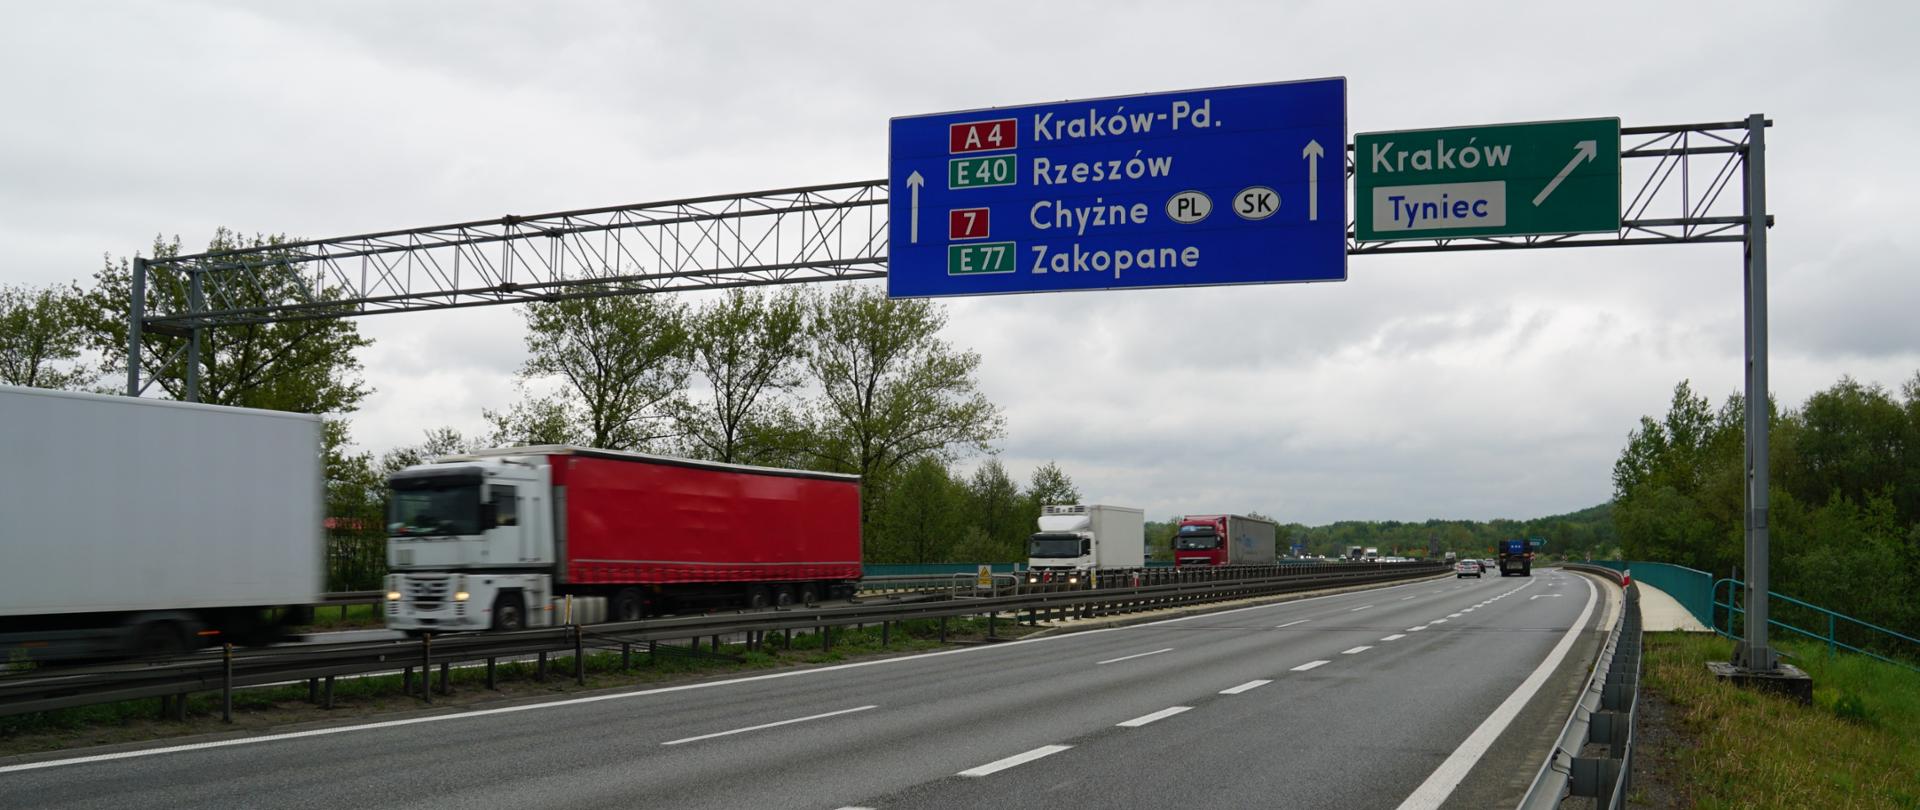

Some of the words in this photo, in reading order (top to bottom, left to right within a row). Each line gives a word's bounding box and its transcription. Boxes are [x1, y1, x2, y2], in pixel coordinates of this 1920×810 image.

[1034, 99, 1222, 142] Kraków-Pd.
[964, 126, 981, 149] A
[987, 123, 1003, 145] 4
[1033, 150, 1172, 185] Rzeszów
[1372, 137, 1512, 174] Kraków
[957, 162, 970, 185] E
[975, 159, 1008, 184] 40
[1029, 197, 1149, 236] Chyżne
[1176, 197, 1202, 218] PL
[1241, 192, 1272, 214] SK
[1388, 193, 1489, 228] Tyniec
[963, 212, 977, 235] 7
[960, 249, 973, 271] E
[979, 246, 1006, 270] 77
[1031, 244, 1201, 279] Zakopane
